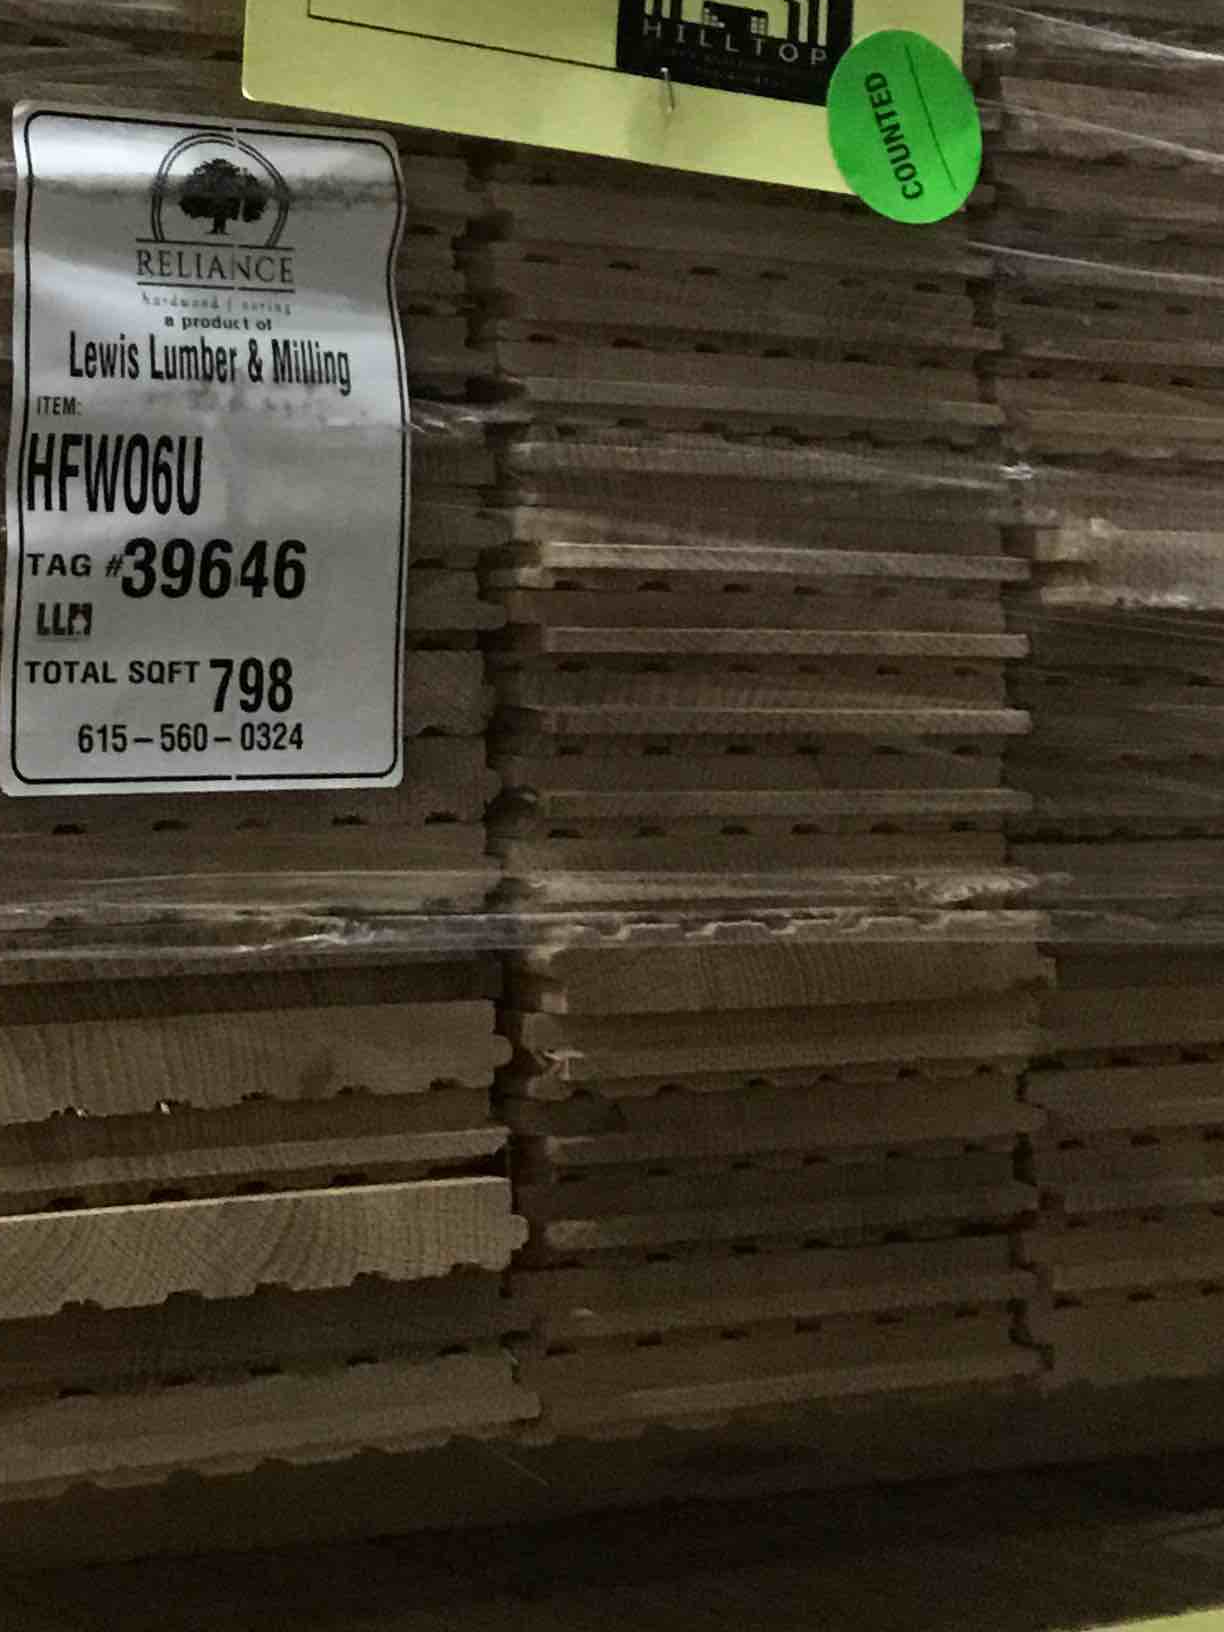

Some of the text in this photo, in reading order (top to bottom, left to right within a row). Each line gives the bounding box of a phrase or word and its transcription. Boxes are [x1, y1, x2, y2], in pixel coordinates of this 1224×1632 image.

[642, 18, 827, 65] HILLTOP
[864, 72, 924, 200] COUNTED
[136, 249, 294, 284] RELIANCE
[164, 315, 272, 330] a product of
[227, 297, 291, 316] fooring
[69, 330, 351, 396] Lewis Lumber & Milling
[36, 395, 82, 416] ITEM:
[26, 553, 92, 576] TAG
[24, 657, 293, 713] TOTAL SQFT 798
